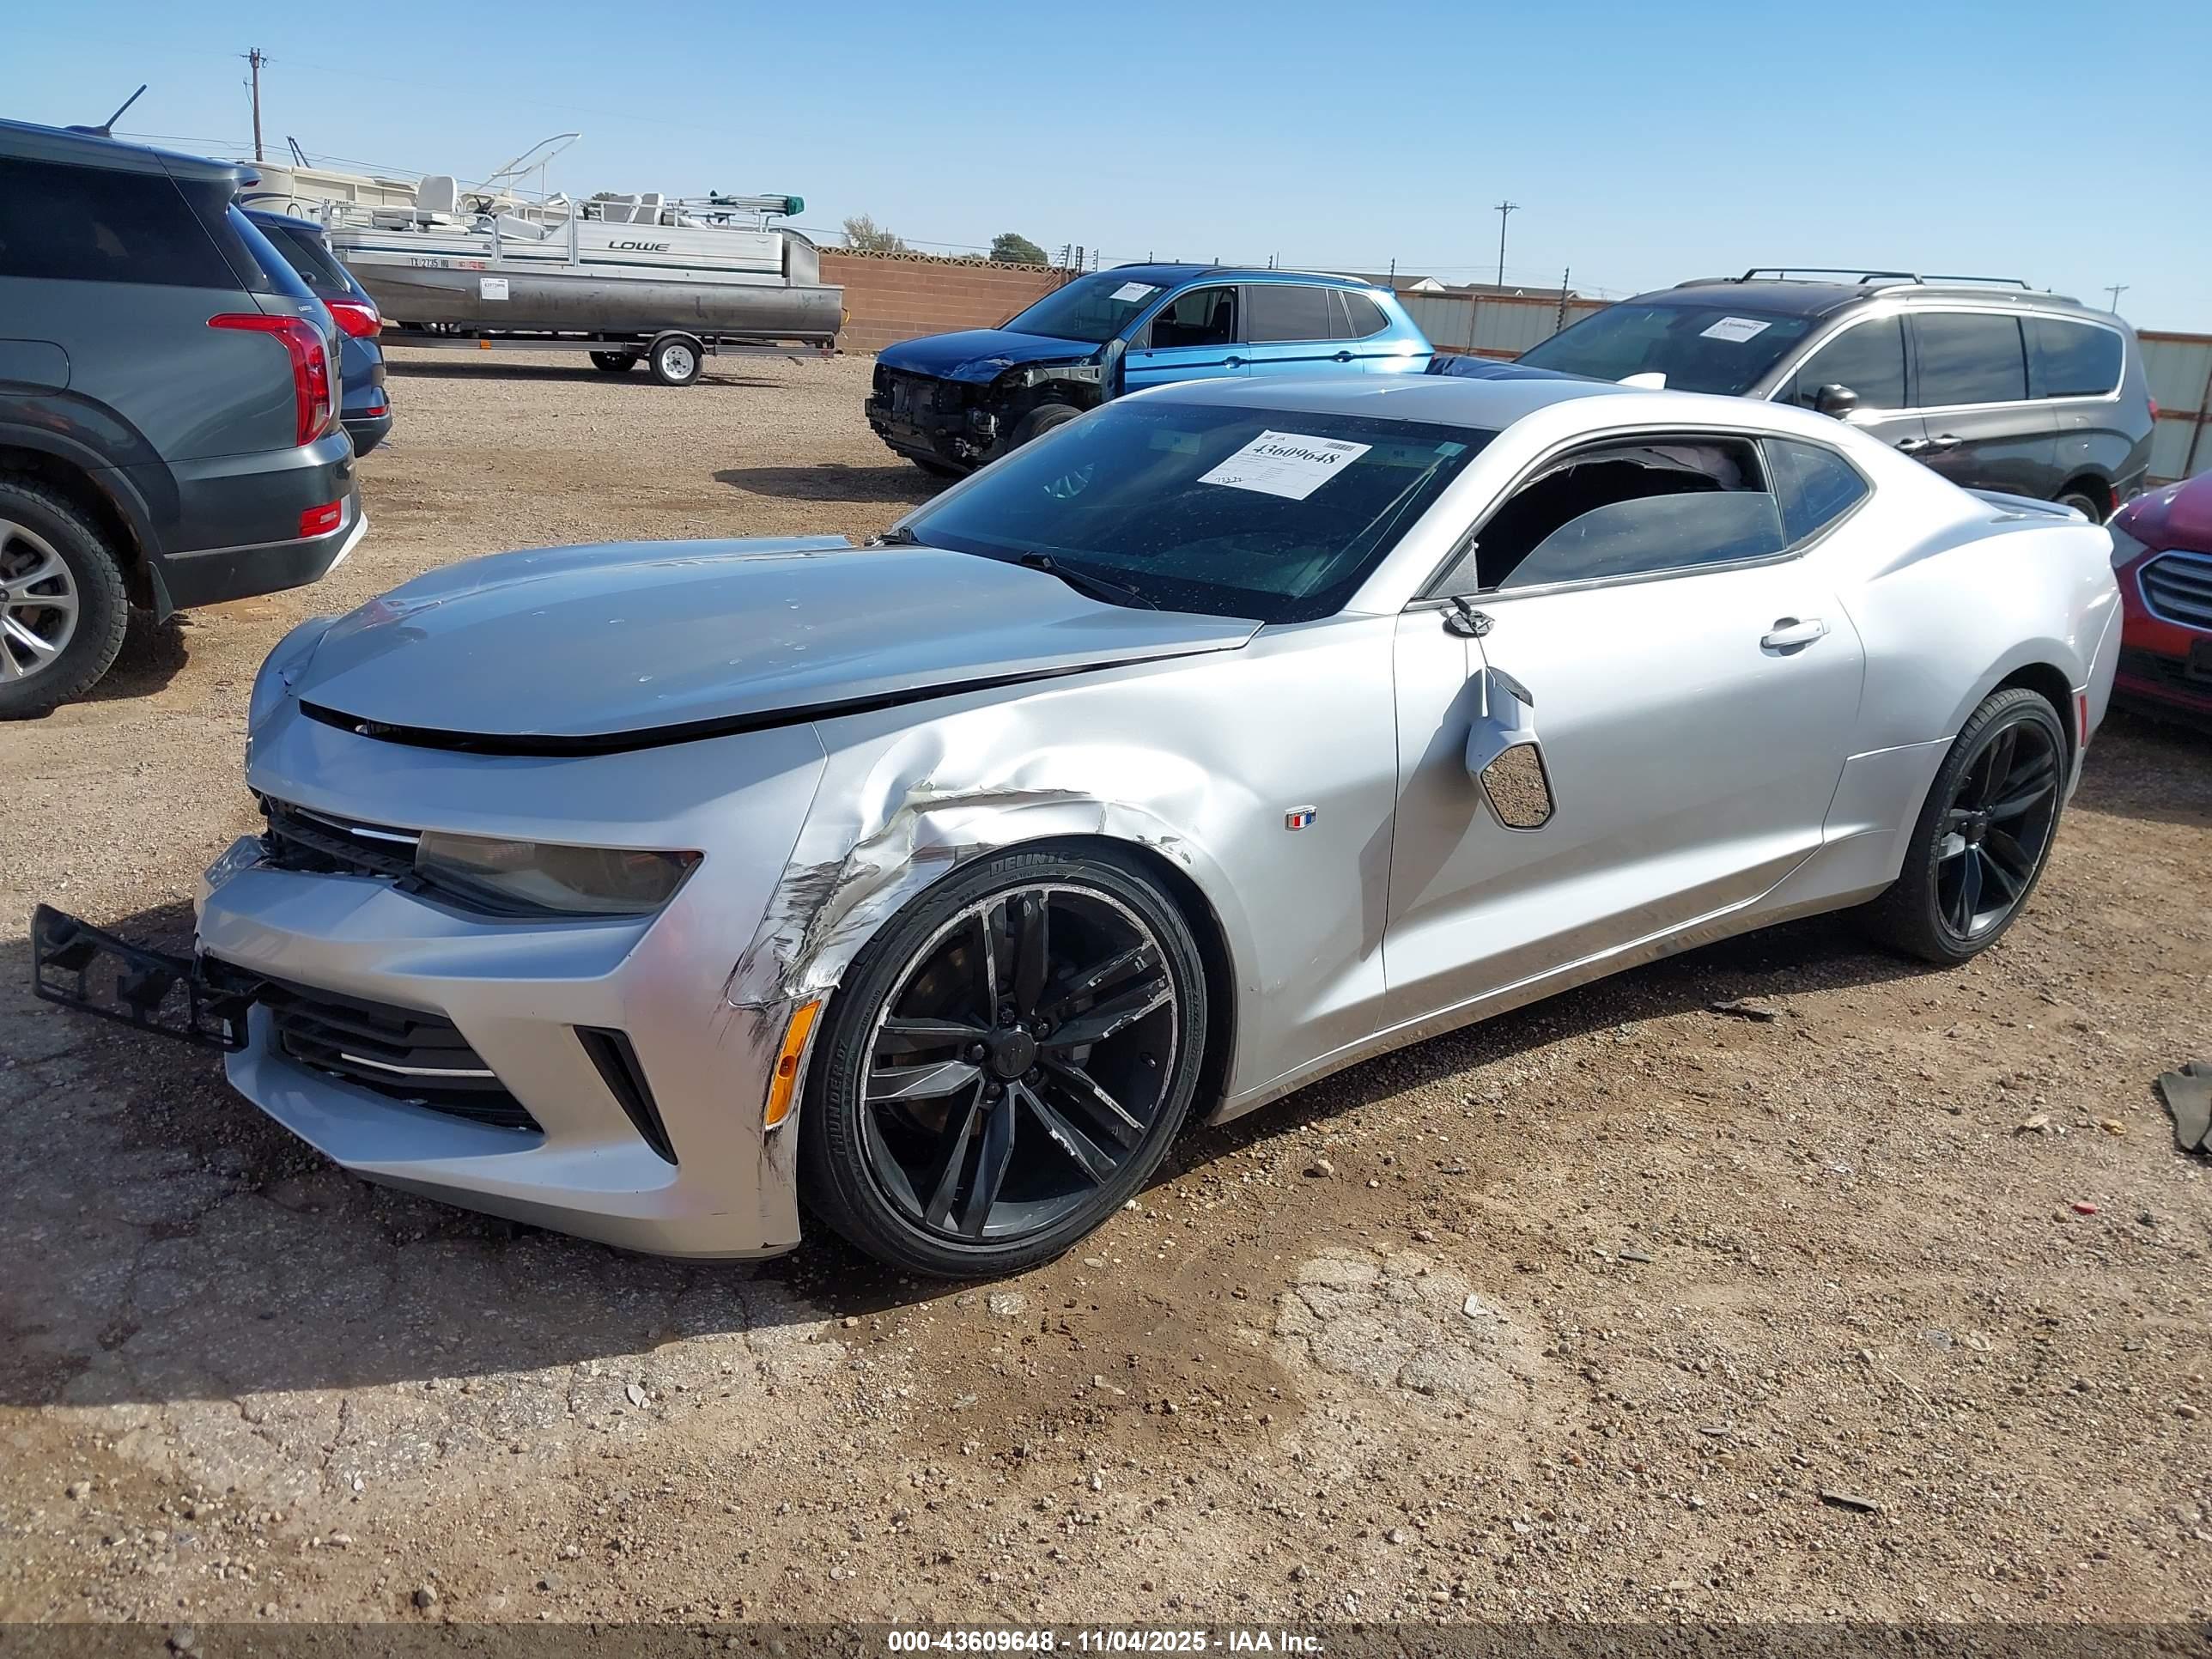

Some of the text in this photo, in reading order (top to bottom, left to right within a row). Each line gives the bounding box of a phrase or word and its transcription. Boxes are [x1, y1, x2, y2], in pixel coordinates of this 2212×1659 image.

[608, 240, 671, 252] LOWE
[1253, 443, 1341, 465] 43609648
[830, 1064, 847, 1158] THUNDER
